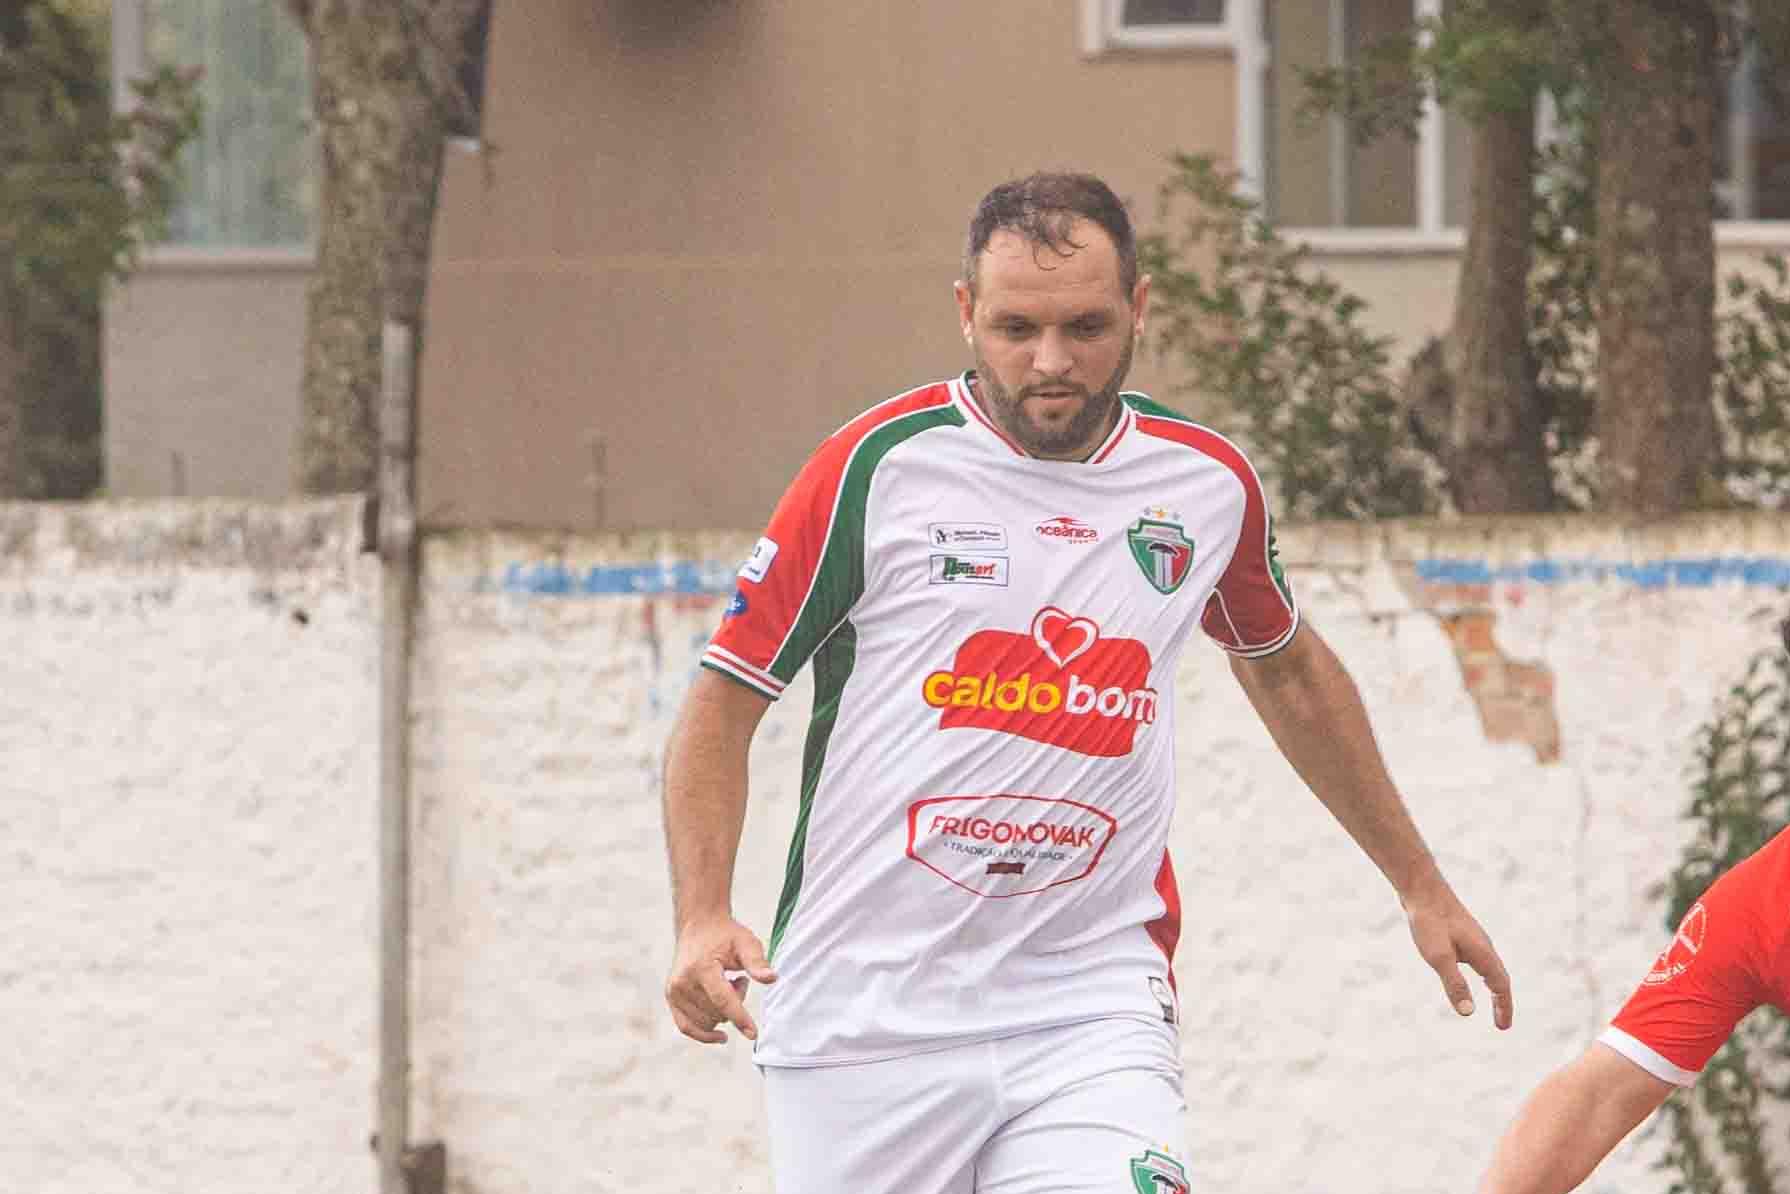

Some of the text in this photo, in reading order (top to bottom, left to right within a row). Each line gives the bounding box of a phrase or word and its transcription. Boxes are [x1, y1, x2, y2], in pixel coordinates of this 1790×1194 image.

[923, 671, 1160, 724] caldo bom
[929, 815, 1096, 848] FRIGONOVAK
